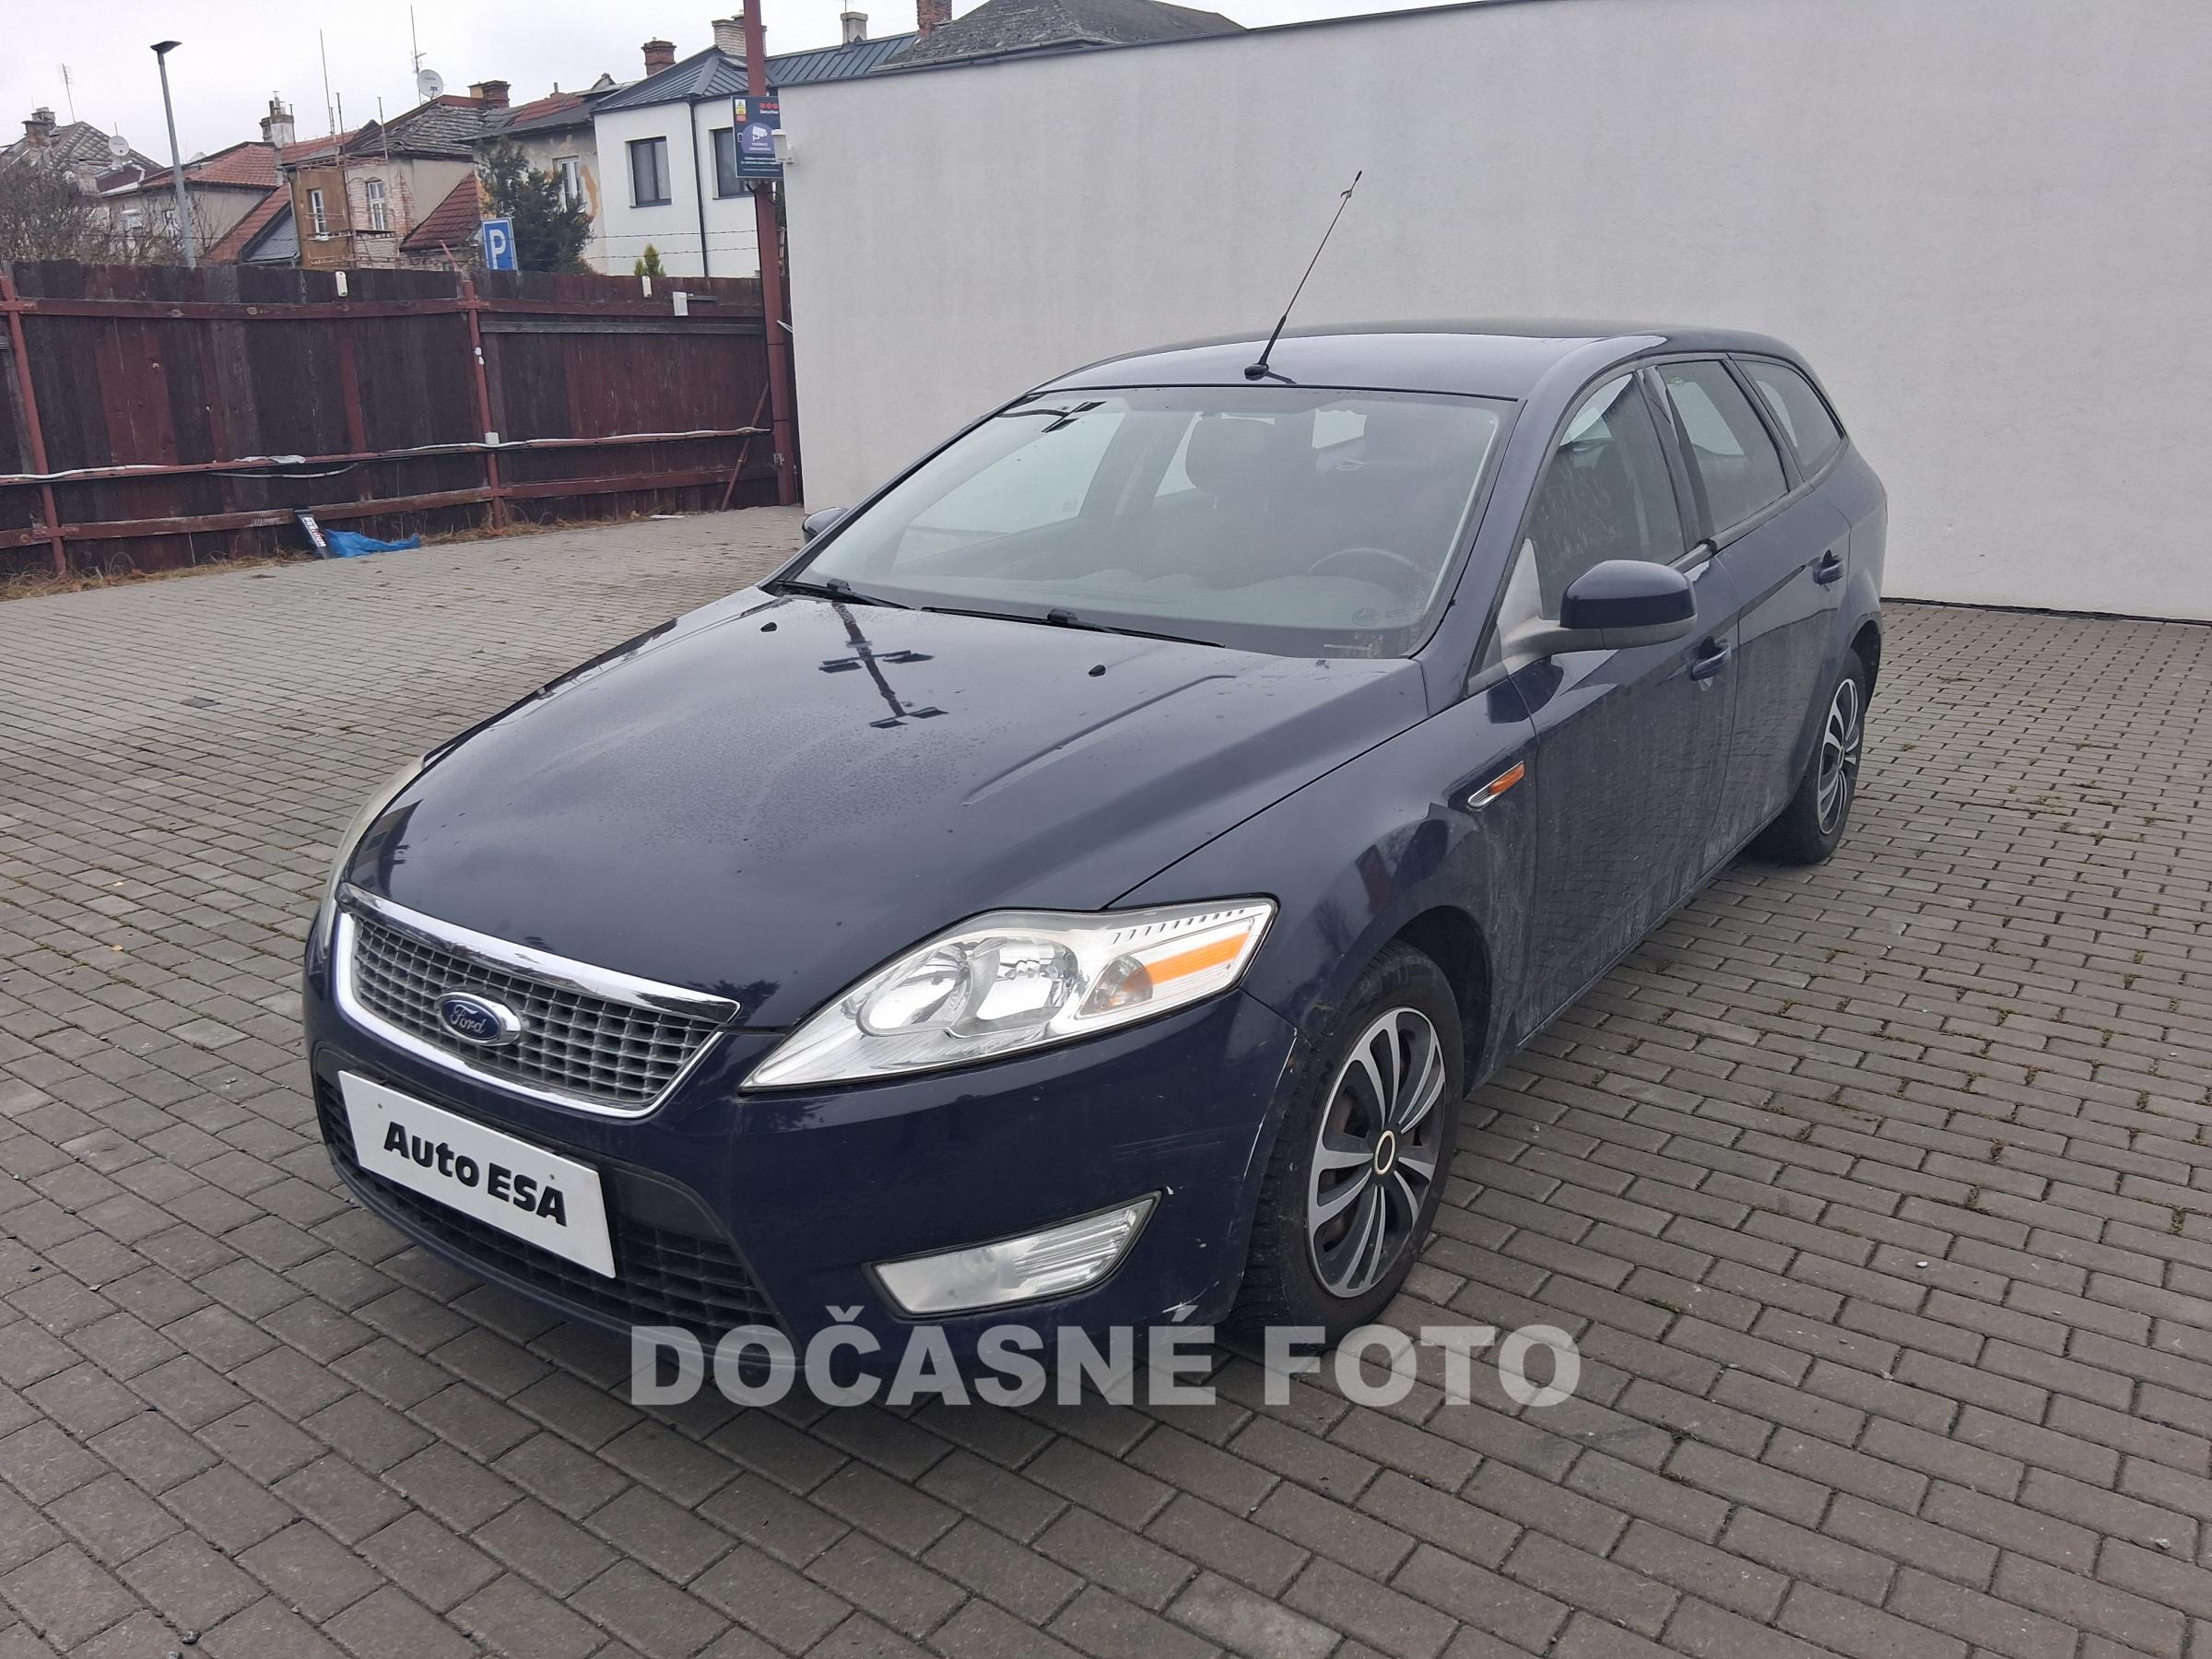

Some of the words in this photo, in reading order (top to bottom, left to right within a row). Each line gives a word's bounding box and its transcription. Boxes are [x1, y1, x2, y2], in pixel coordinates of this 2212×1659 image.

[489, 229, 506, 270] P
[451, 1004, 488, 1034] Ford
[383, 1121, 480, 1188] Auto
[487, 1161, 568, 1228] ESA
